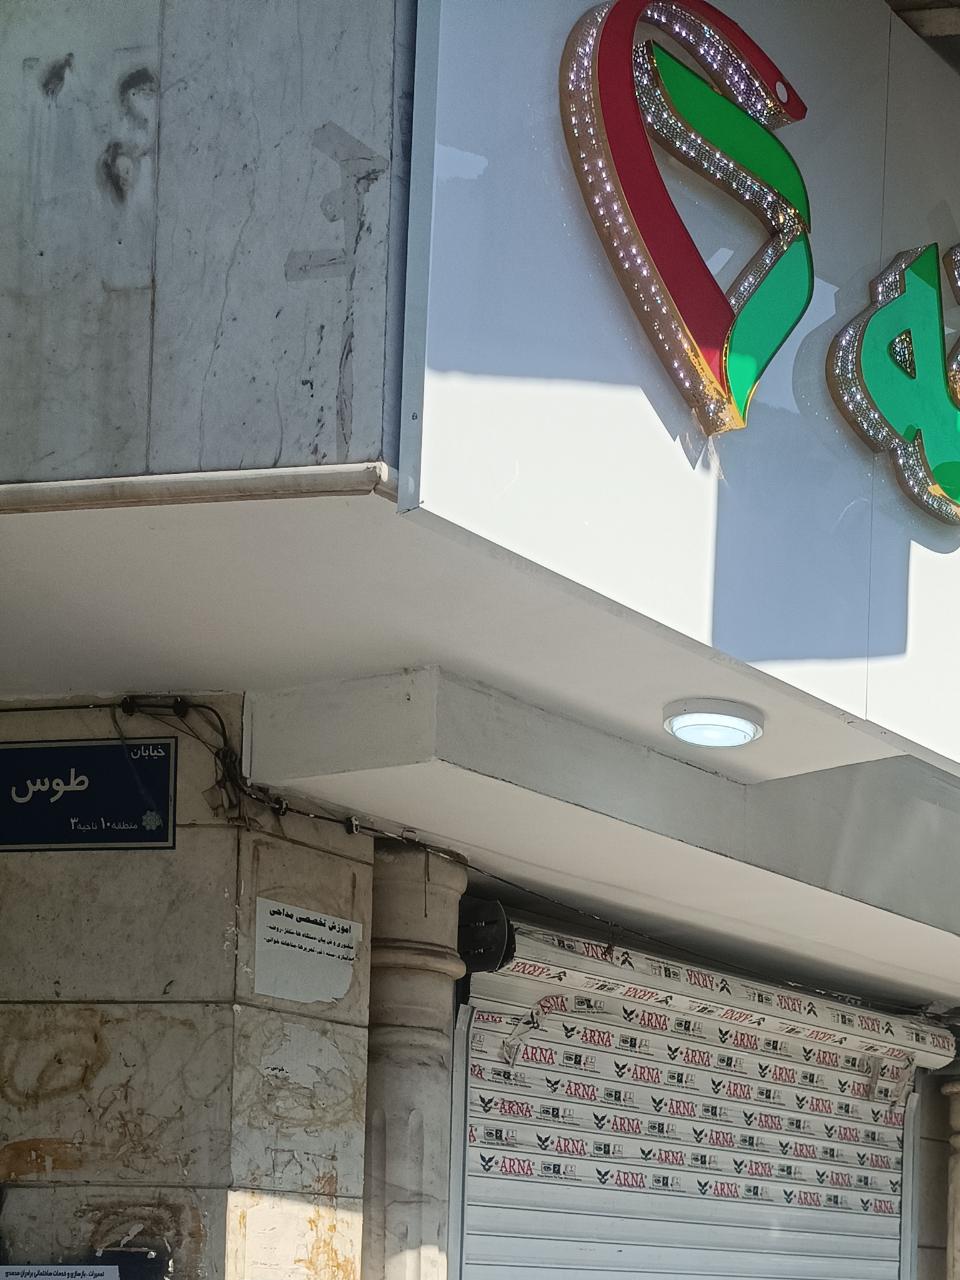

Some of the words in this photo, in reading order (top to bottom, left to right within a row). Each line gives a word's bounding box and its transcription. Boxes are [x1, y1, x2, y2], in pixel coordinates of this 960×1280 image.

[131, 746, 166, 759] خیابان
[11, 767, 90, 804] طوس
[295, 915, 326, 928] تخصصی
[639, 1012, 669, 1031] ARNA
[579, 1028, 613, 1047] ARNA
[732, 1031, 759, 1050] ARNA
[520, 1046, 555, 1064] ARNA
[681, 1048, 711, 1065] ARNA
[816, 1049, 840, 1067] ARNA
[631, 1065, 661, 1083] ARNA
[771, 1065, 796, 1083] ARNA
[564, 1082, 598, 1100] ARNA
[726, 1083, 751, 1099] ARNA
[497, 1102, 531, 1116] ARNA
[667, 1101, 695, 1115] ARNA
[610, 1117, 641, 1133] ARNA
[756, 1114, 781, 1130] ARNA
[554, 1139, 586, 1155] ARNA
[656, 1150, 683, 1164] ARNA
[500, 1158, 533, 1175] ARNA
[613, 1173, 644, 1186] ARNA
